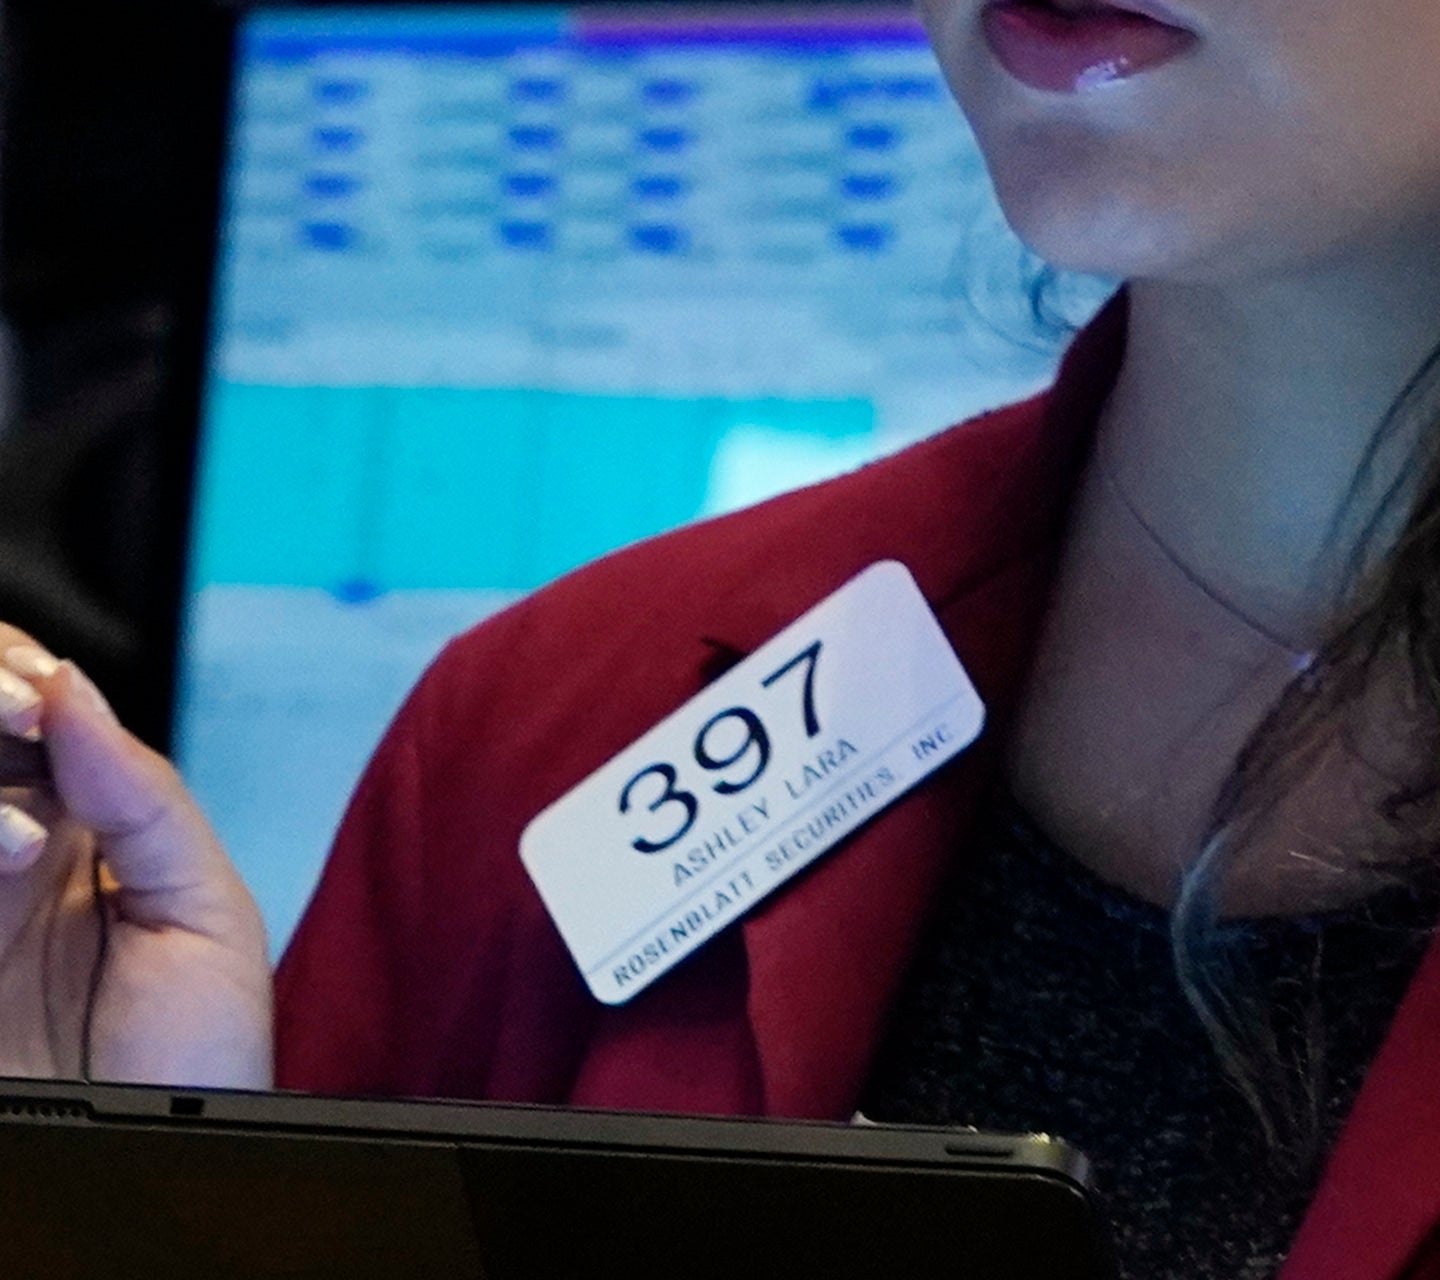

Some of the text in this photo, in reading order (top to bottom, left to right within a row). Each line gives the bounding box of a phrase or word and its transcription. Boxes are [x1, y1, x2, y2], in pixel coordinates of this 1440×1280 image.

[617, 639, 824, 855] 397
[673, 736, 859, 887] ASHLEY LARA
[612, 723, 956, 988] ROSENBLATT SECURITIES INC
